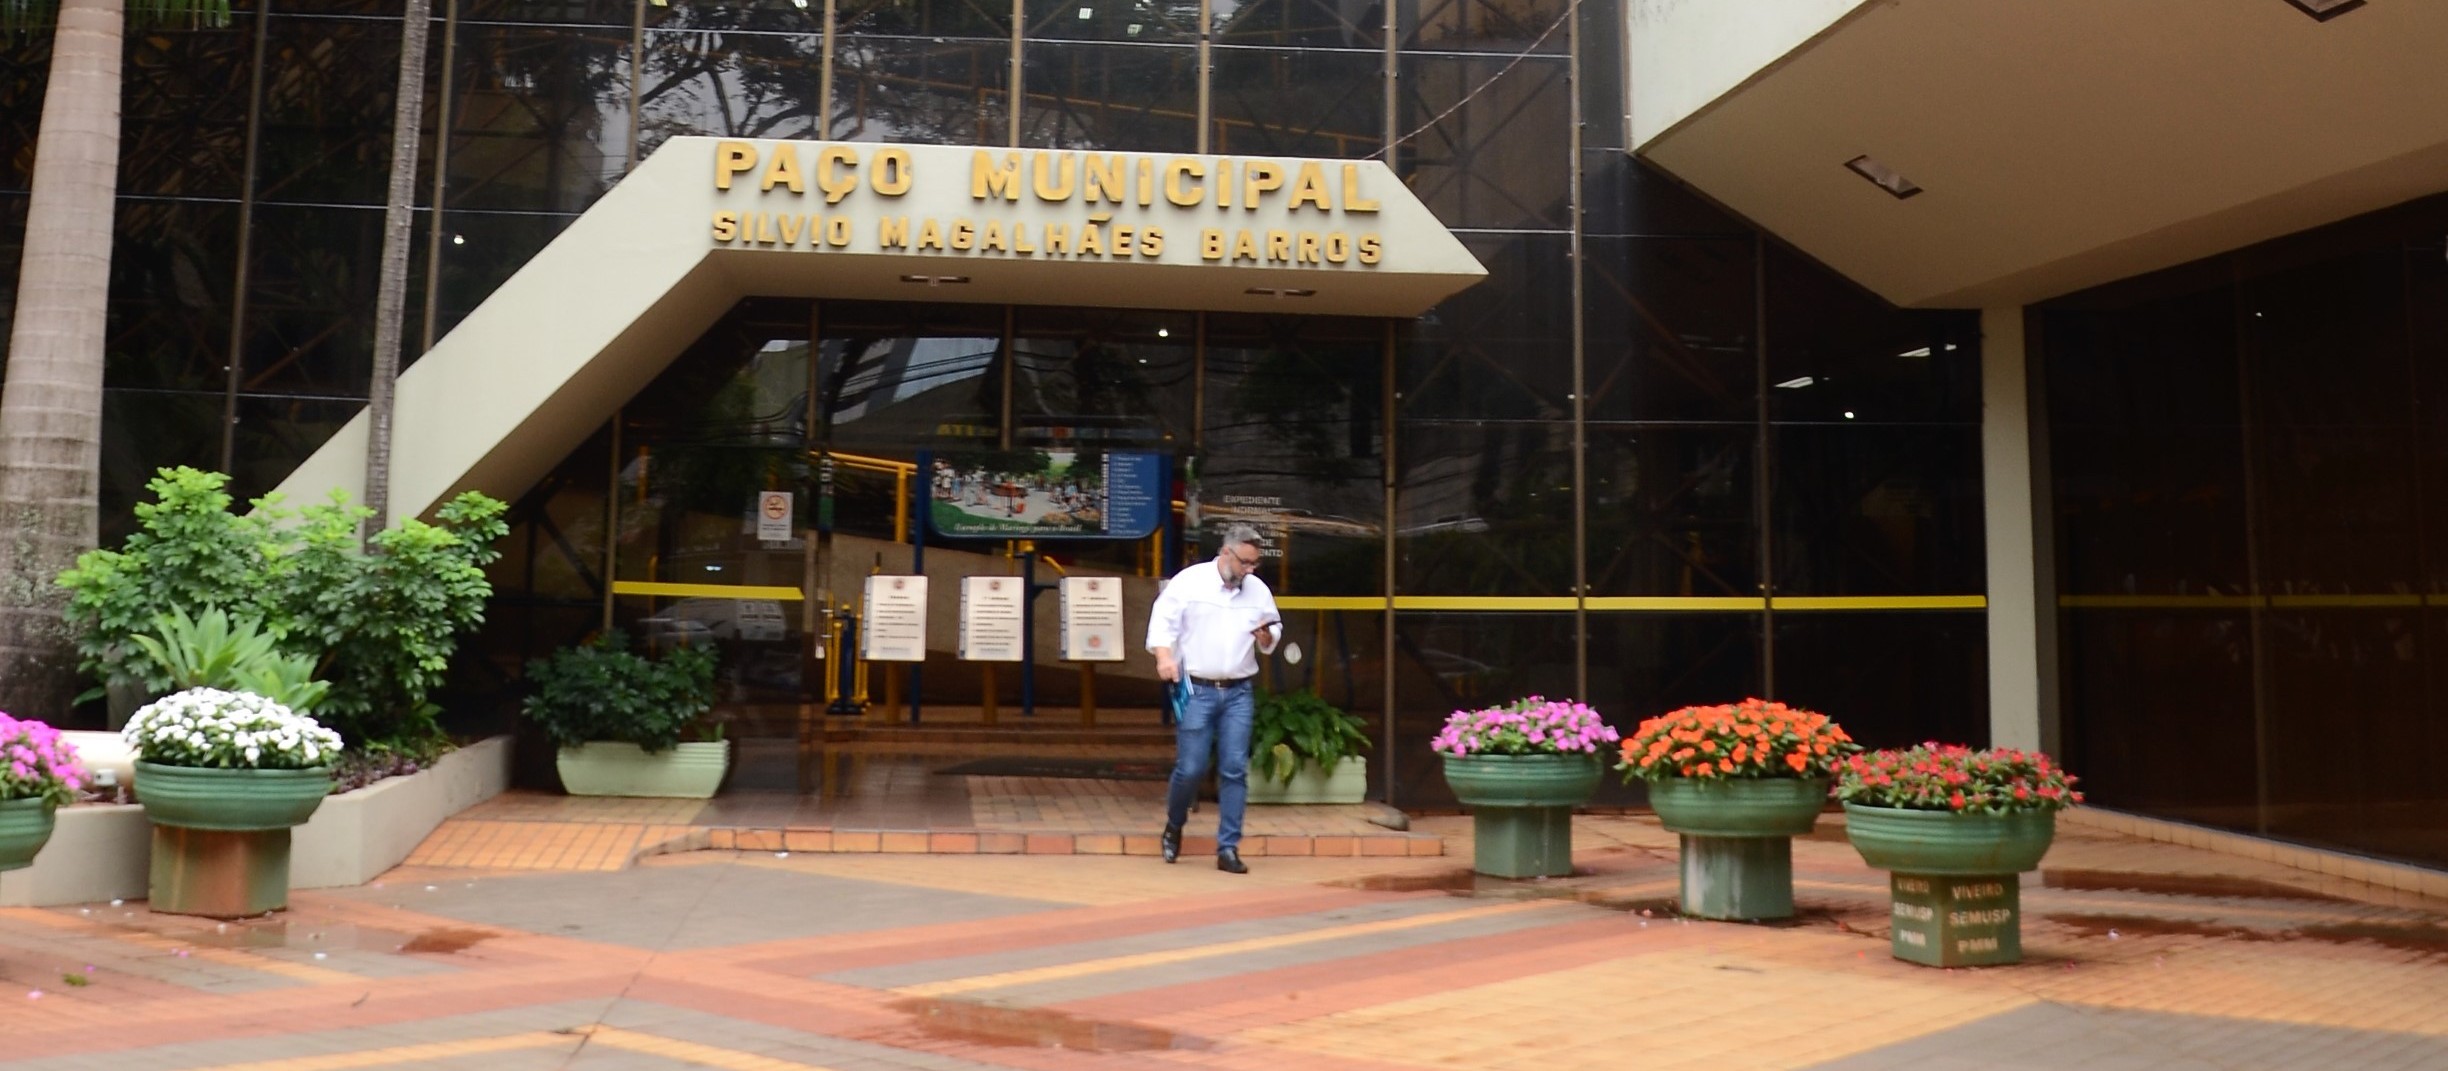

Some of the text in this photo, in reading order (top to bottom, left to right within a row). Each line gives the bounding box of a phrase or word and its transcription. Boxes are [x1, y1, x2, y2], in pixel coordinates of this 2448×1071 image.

[715, 141, 1380, 213] PAÇO MUNICIPAL
[712, 211, 1383, 265] SILVIO MAGALHÃES BARROS
[1224, 495, 1281, 505] EXPEDIENTE
[1952, 884, 2003, 899] VIVEIRO
[1894, 902, 1934, 922] SEMUSP
[1950, 909, 2011, 925] SEMUSP
[1958, 938, 1998, 952] PMM
